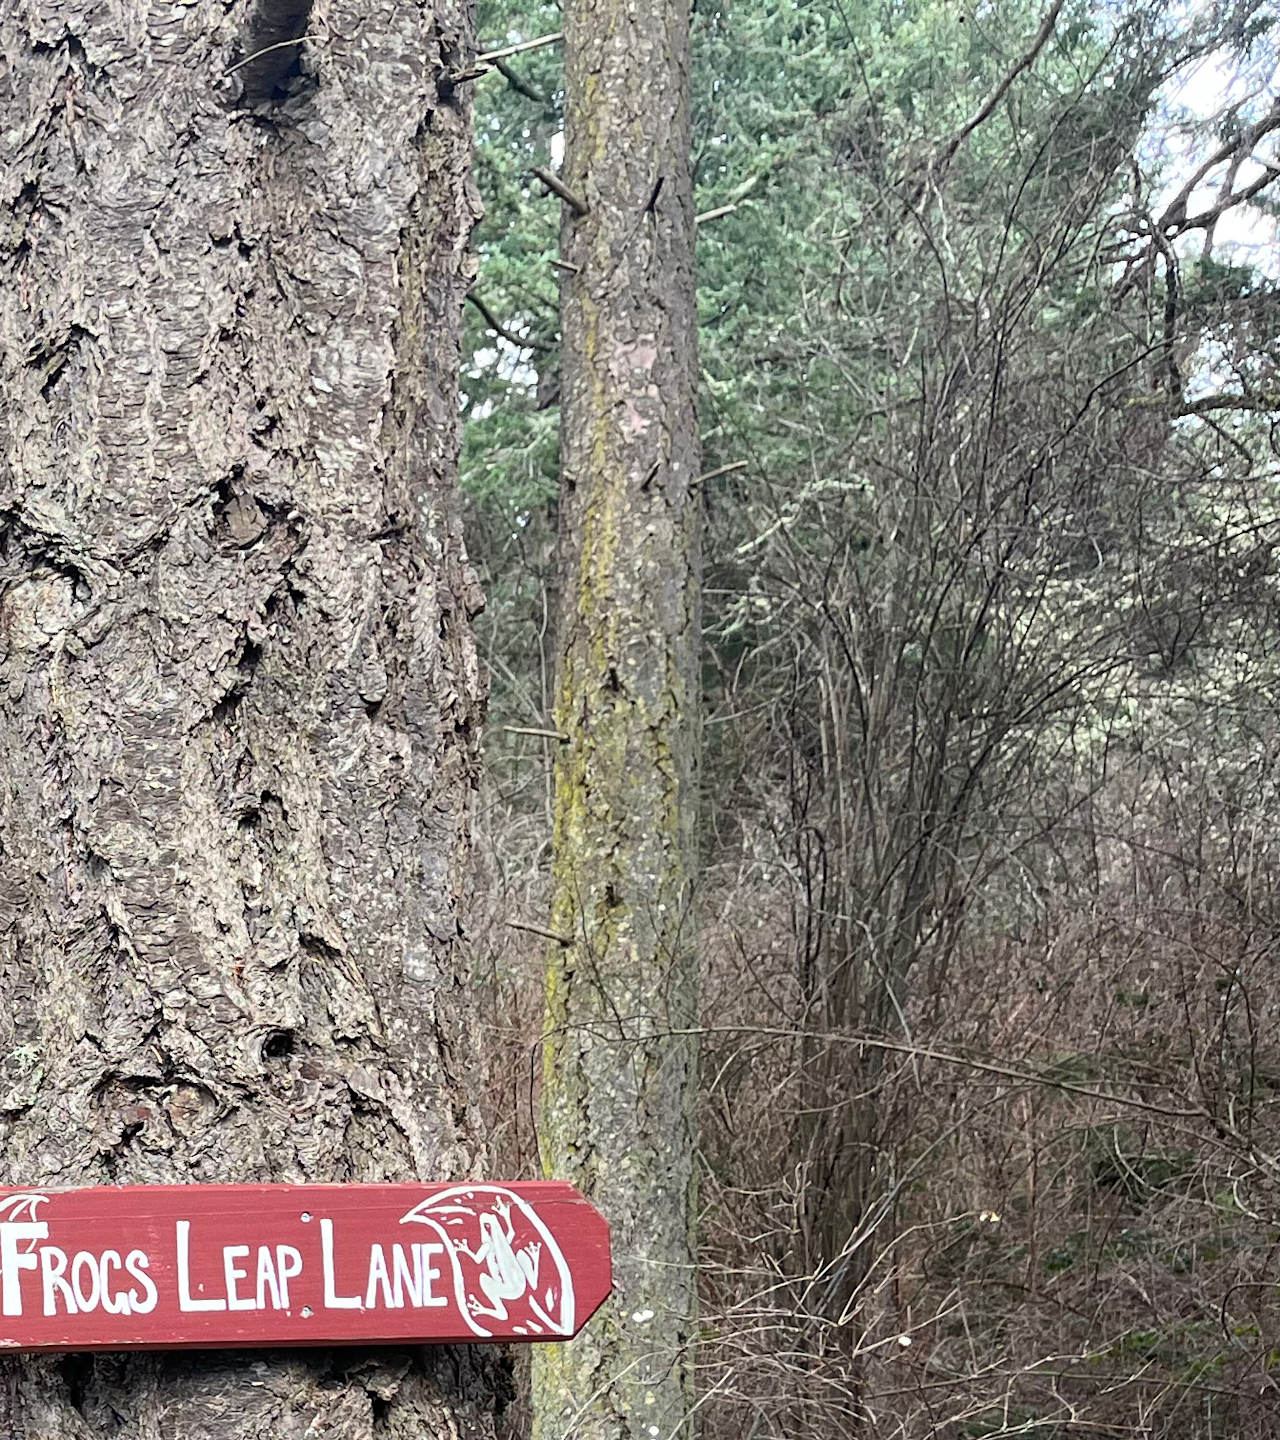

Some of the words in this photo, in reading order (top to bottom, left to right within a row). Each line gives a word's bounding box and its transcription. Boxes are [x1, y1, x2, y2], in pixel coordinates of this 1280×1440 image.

[0, 1221, 158, 1317] FROGS
[176, 1219, 303, 1312] LEAP
[320, 1218, 448, 1309] LANE
